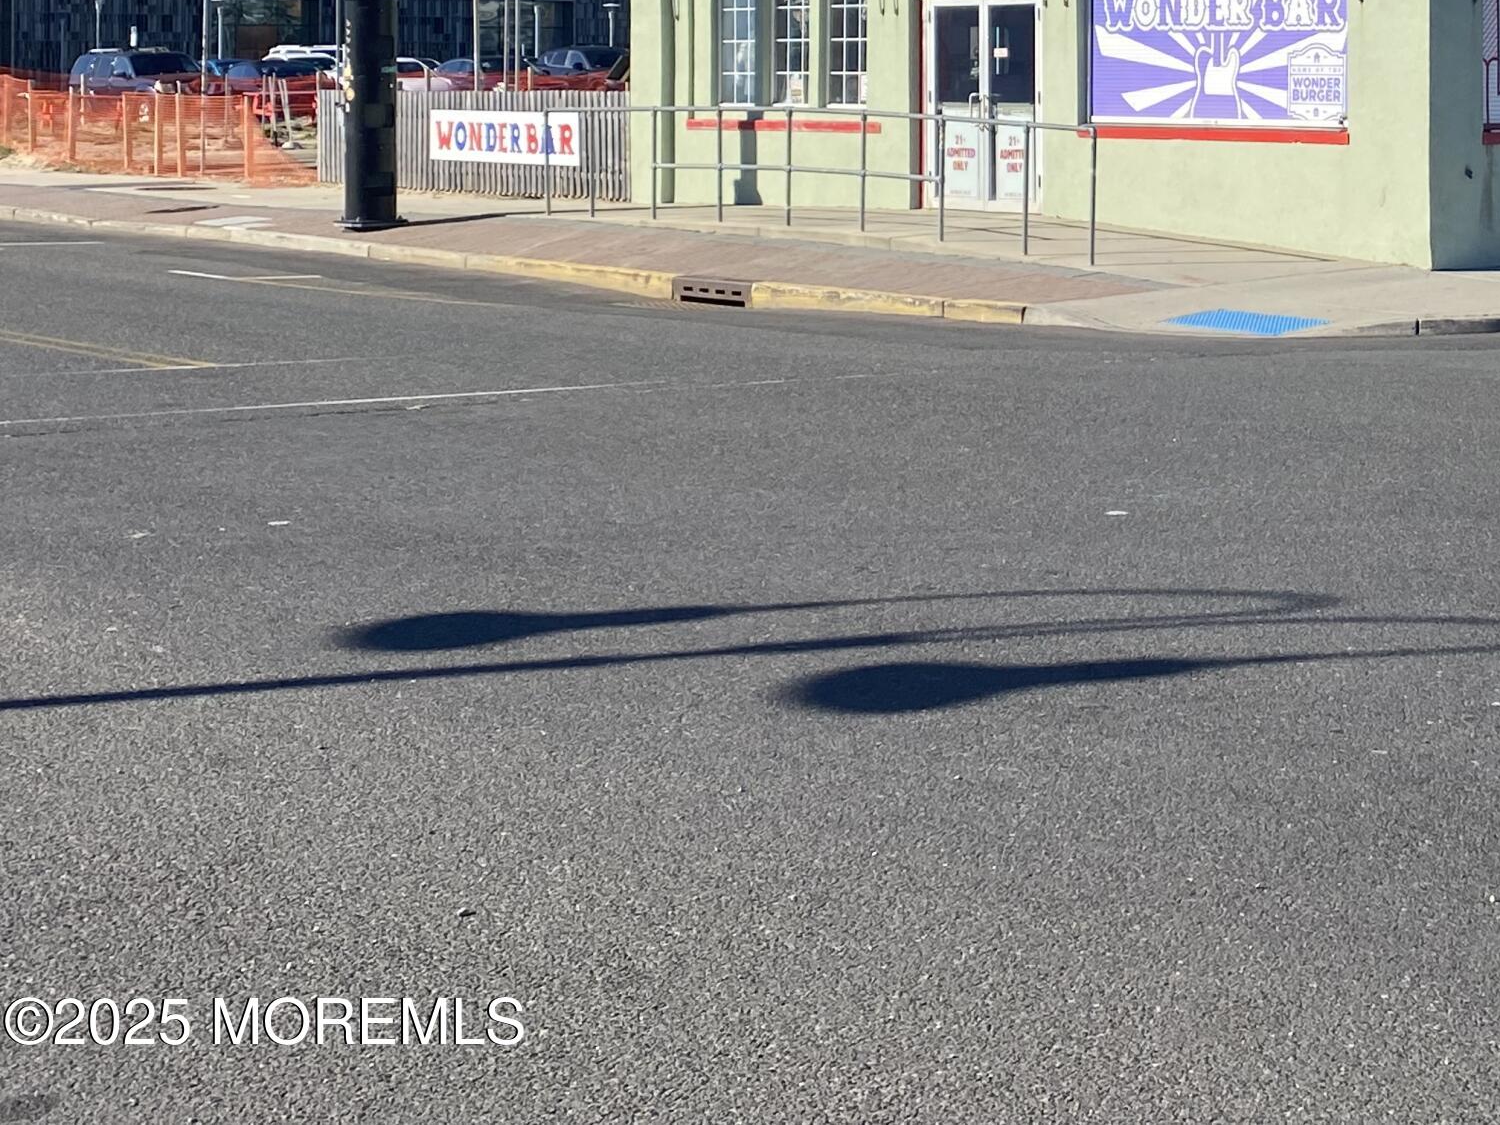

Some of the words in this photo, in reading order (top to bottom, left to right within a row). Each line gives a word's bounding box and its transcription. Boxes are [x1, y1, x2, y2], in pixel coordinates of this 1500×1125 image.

[1292, 77, 1341, 89] WONDER
[1292, 88, 1341, 103] BURGER
[435, 120, 522, 154] WONDER
[525, 122, 575, 156] BAR
[946, 147, 976, 159] ADMITTED
[952, 160, 968, 172] ONLY
[1006, 162, 1022, 173] ONLY
